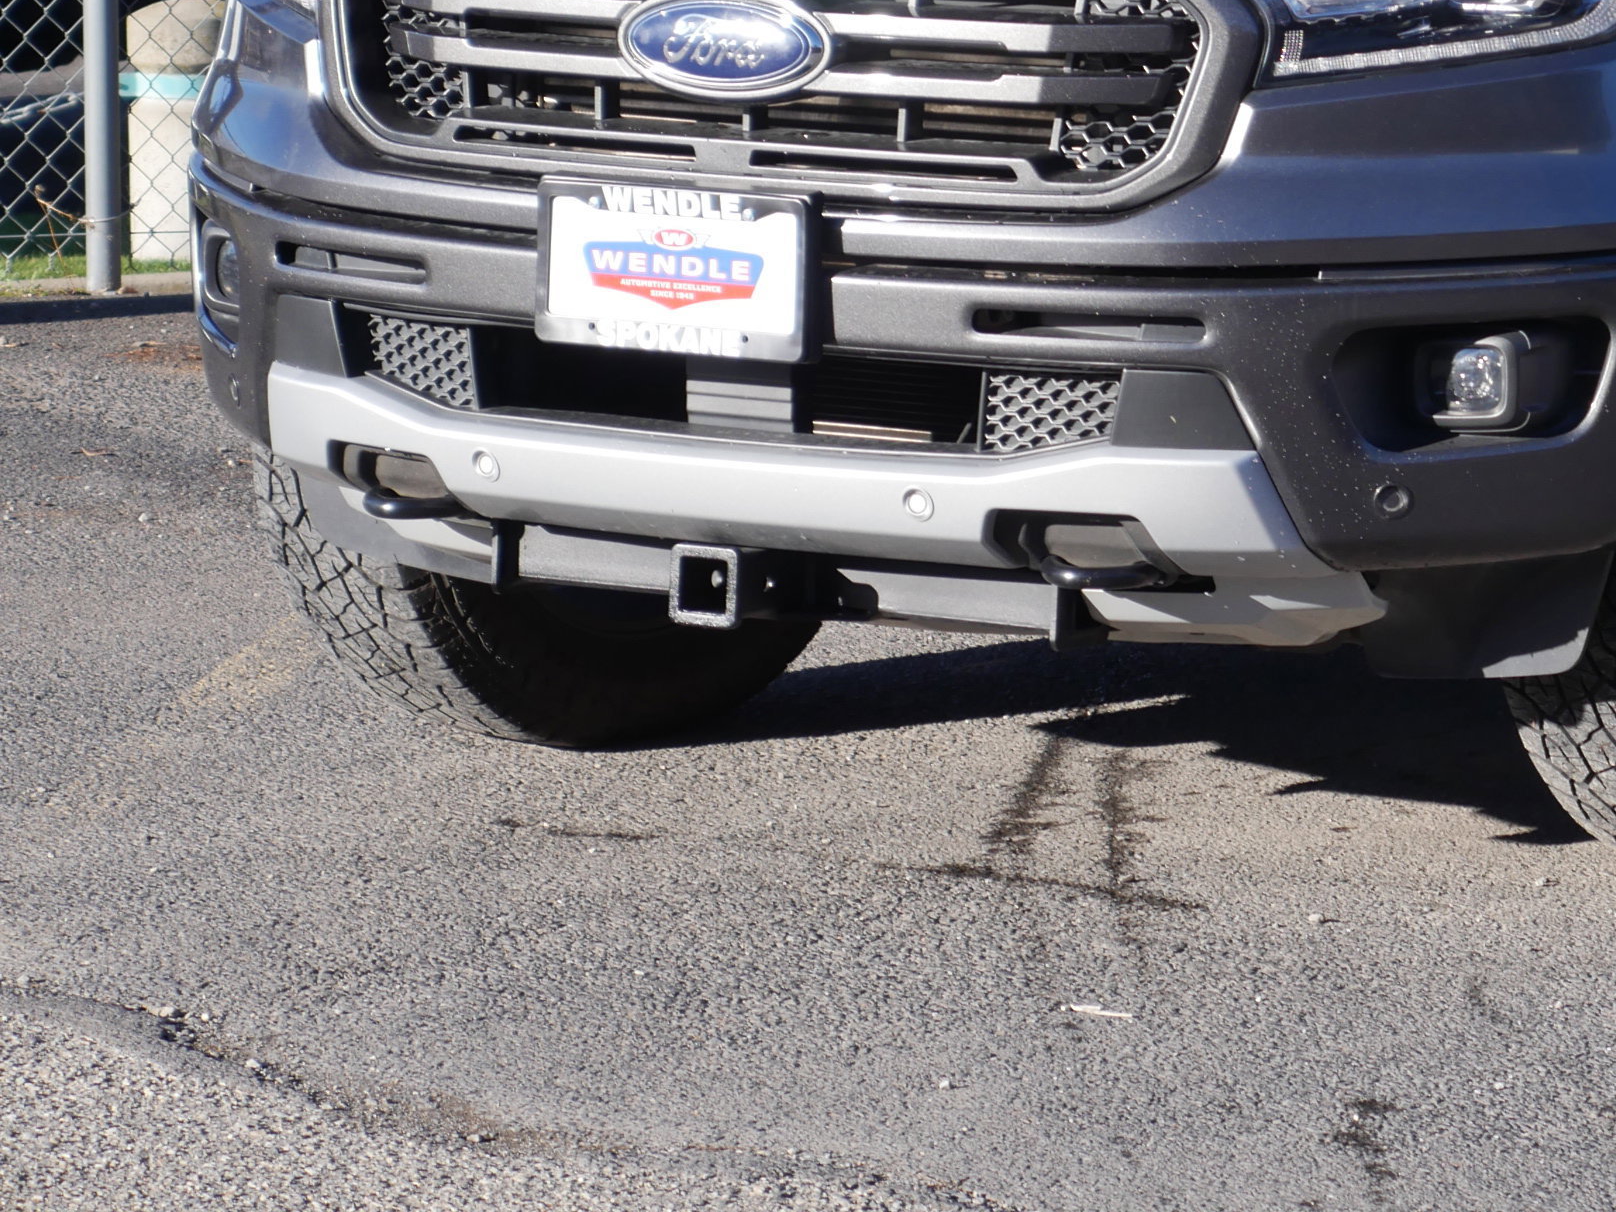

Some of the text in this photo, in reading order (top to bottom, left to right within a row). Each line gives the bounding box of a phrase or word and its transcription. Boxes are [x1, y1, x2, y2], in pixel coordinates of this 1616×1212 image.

[662, 12, 768, 70] Ford
[601, 185, 743, 221] WENDLE
[591, 249, 751, 281] WENDLE
[620, 278, 723, 294] AUTOMOTIVE EXCELLENCE
[650, 289, 674, 299] SINCE
[596, 318, 741, 358] SPOKANE
